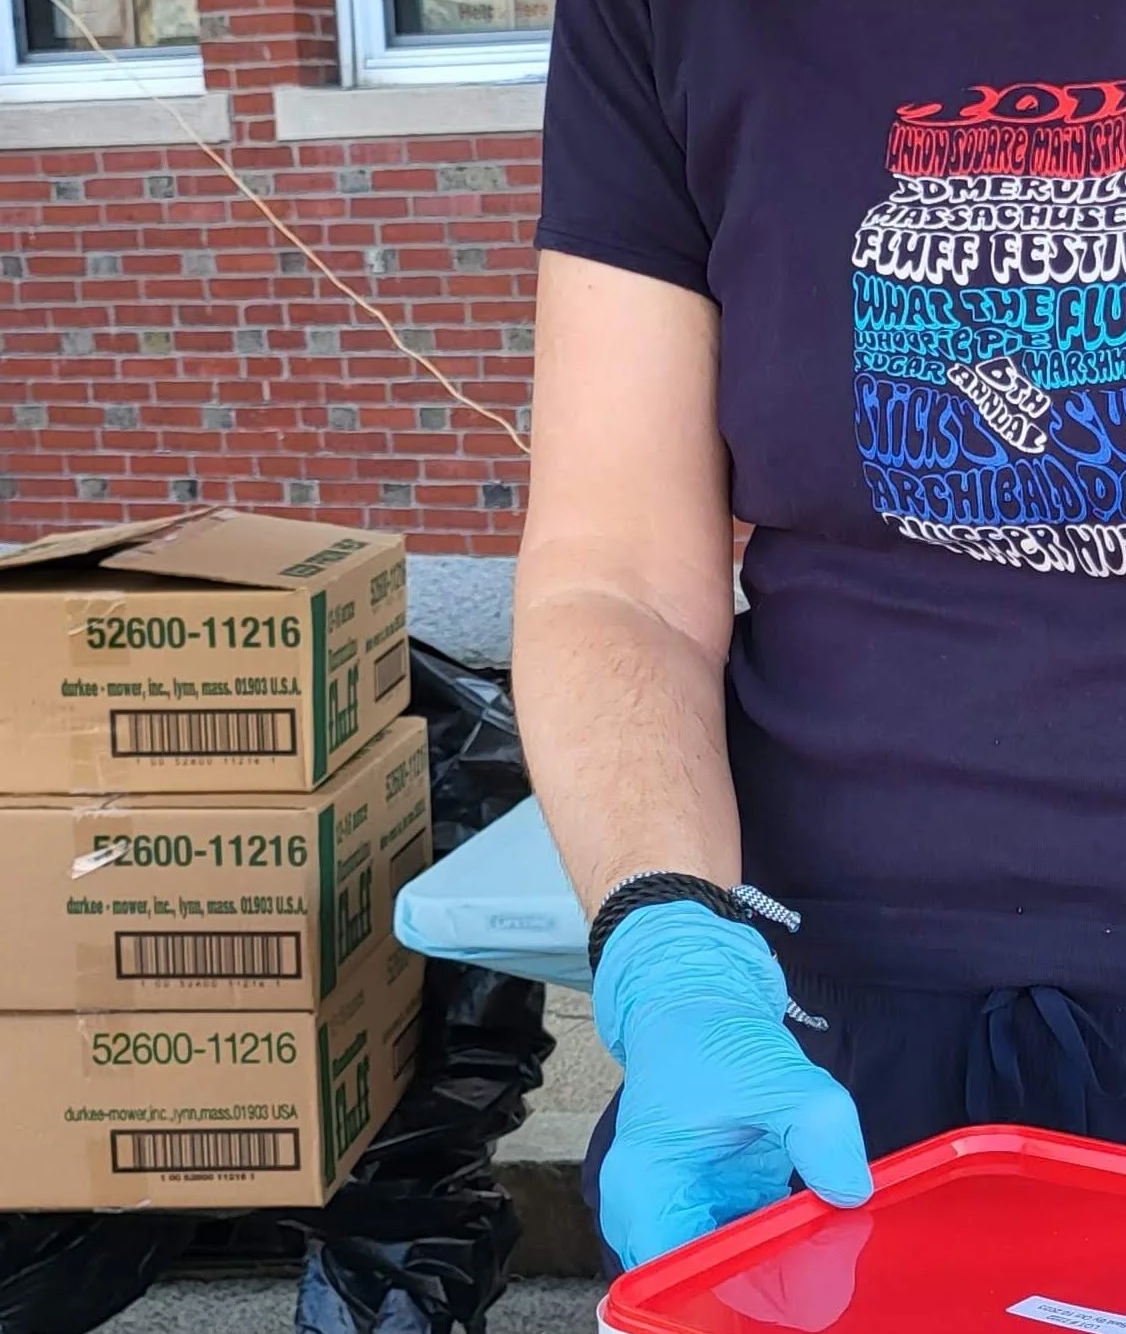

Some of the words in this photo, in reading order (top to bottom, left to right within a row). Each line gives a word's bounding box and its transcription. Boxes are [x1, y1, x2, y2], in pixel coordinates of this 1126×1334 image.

[949, 124, 1029, 176] SQUARE
[852, 226, 980, 285] FLUFF
[852, 272, 960, 331] WHAT
[959, 287, 1055, 332] THE
[853, 327, 972, 362] WHOOPIE
[973, 327, 1051, 358] PIE
[853, 351, 947, 385] SUGAR
[854, 373, 1009, 466] STICKY
[946, 363, 1047, 454] ANNUAL
[863, 458, 1086, 524] ARCHIBALD
[86, 616, 301, 650] 52600-11216
[235, 677, 267, 695] 01903
[270, 677, 302, 695] U.S.A.
[112, 898, 151, 919] mower,
[207, 899, 238, 915] mass.
[240, 896, 273, 915] 01903
[276, 896, 308, 916] U.S.A.
[92, 1031, 297, 1065] 52600-11216
[272, 1104, 298, 1120] USA
